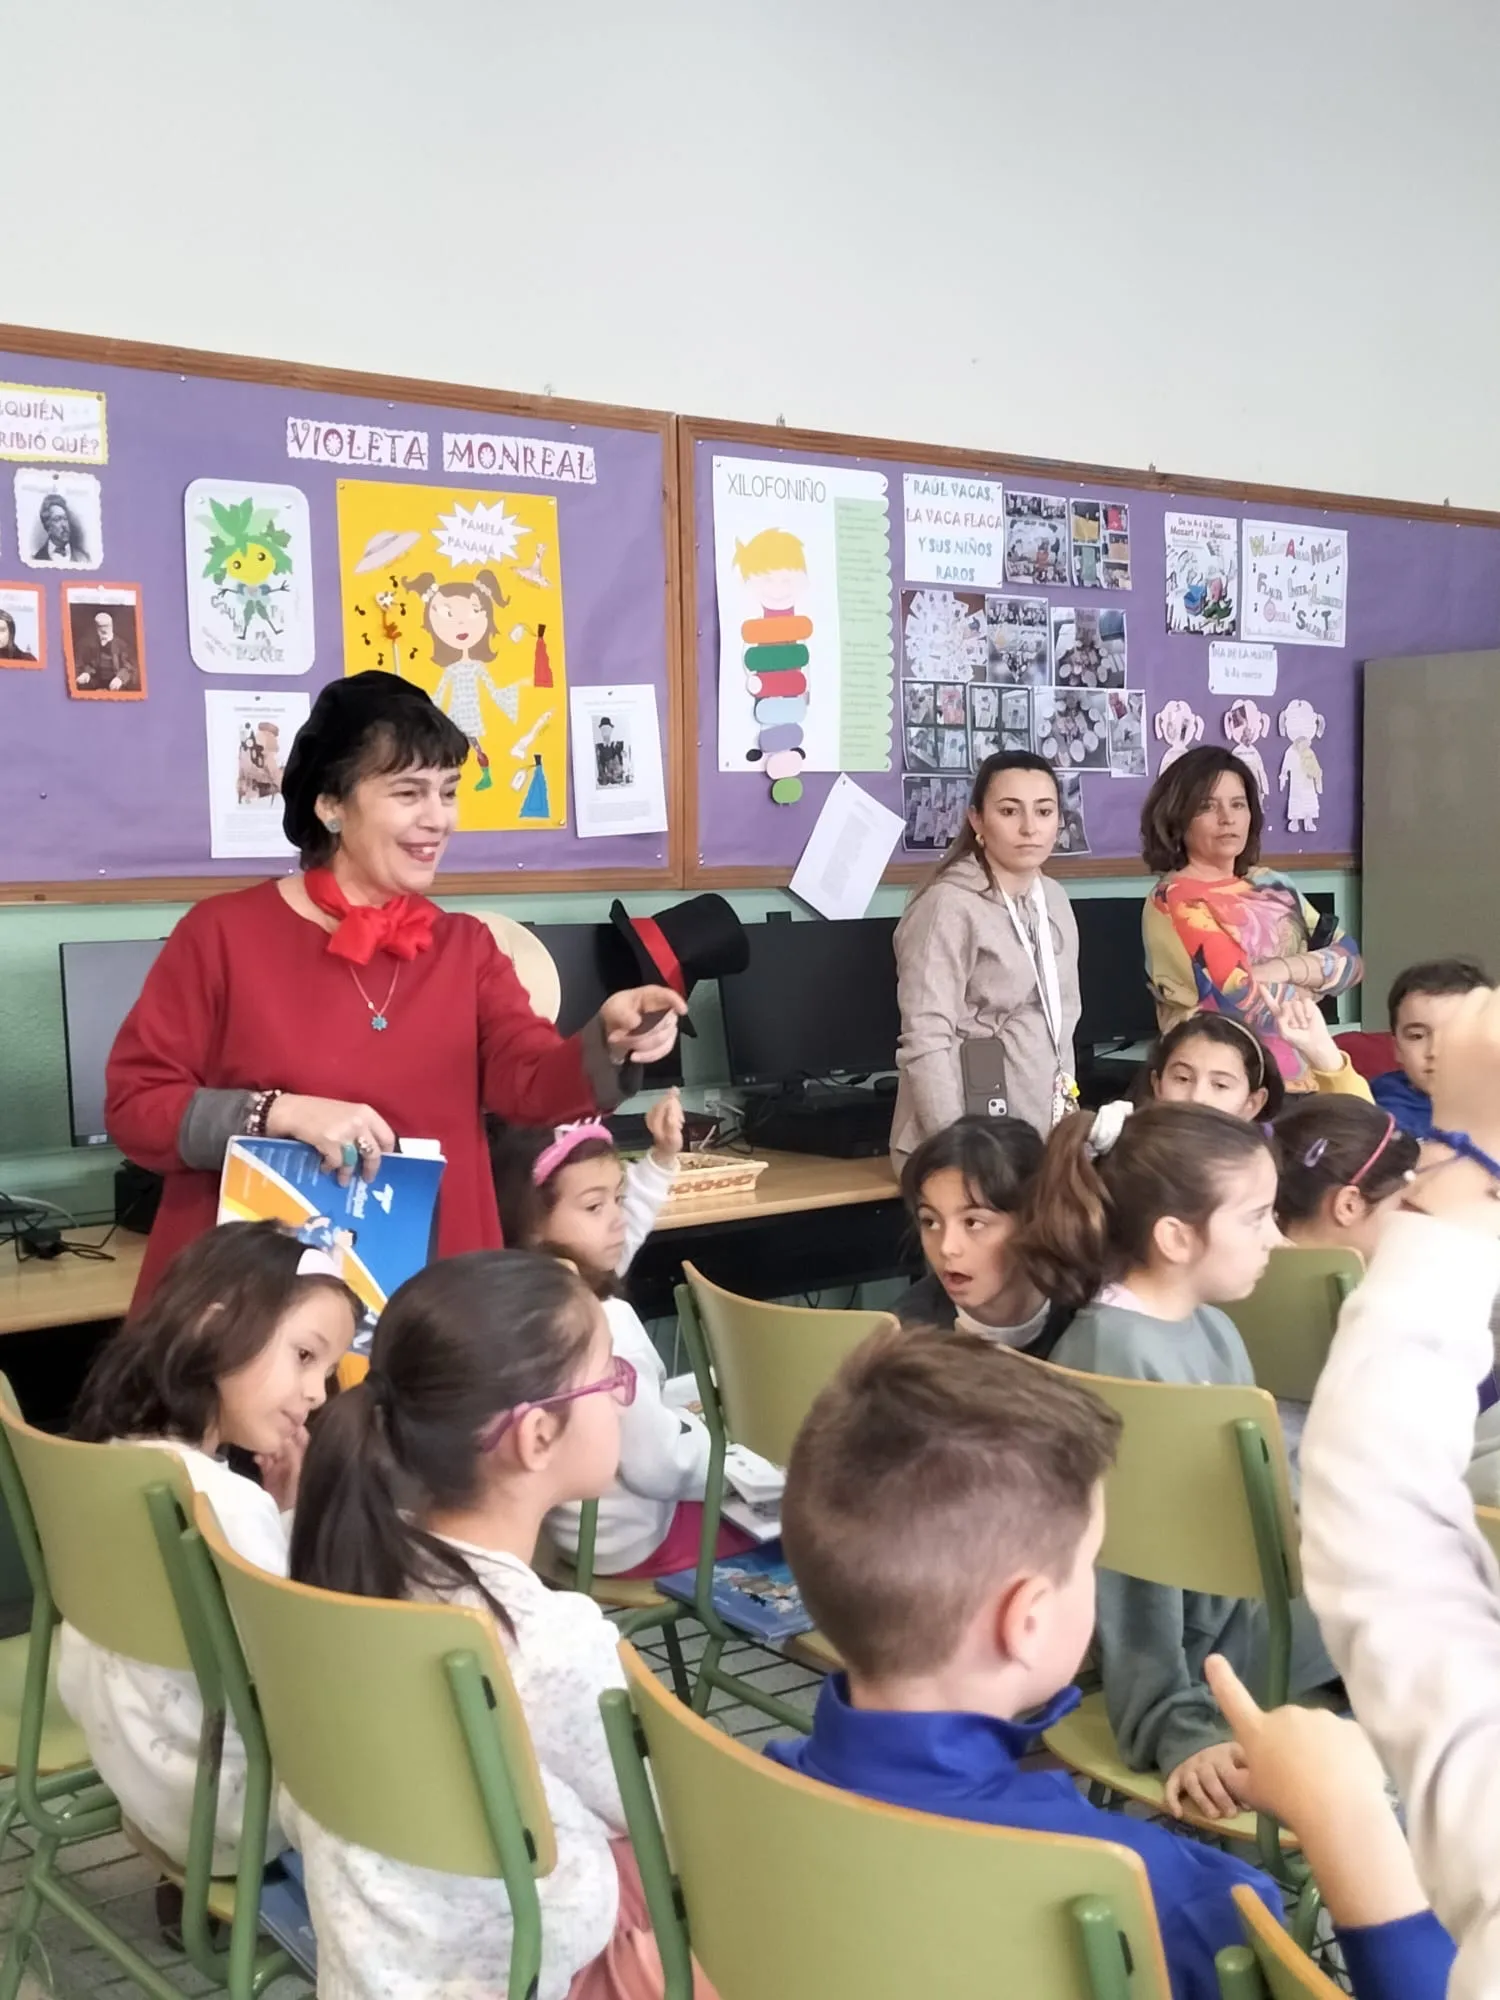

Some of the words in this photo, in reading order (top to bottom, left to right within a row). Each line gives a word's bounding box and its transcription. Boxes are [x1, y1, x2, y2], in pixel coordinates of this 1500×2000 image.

[52, 433, 99, 455] QUÉ?
[290, 421, 426, 466] VIOLETA
[447, 438, 594, 480] MONREAL
[727, 473, 827, 503] XILOFONIÑO
[913, 478, 949, 497] RAÚL
[461, 518, 504, 536] PAMELA
[906, 507, 921, 523] LA
[926, 508, 960, 526] VACA
[964, 512, 1002, 529] FLACA
[918, 537, 927, 552] Y
[928, 538, 951, 554] SUS
[954, 537, 993, 557] NIÑOS
[936, 566, 976, 582] RAROS
